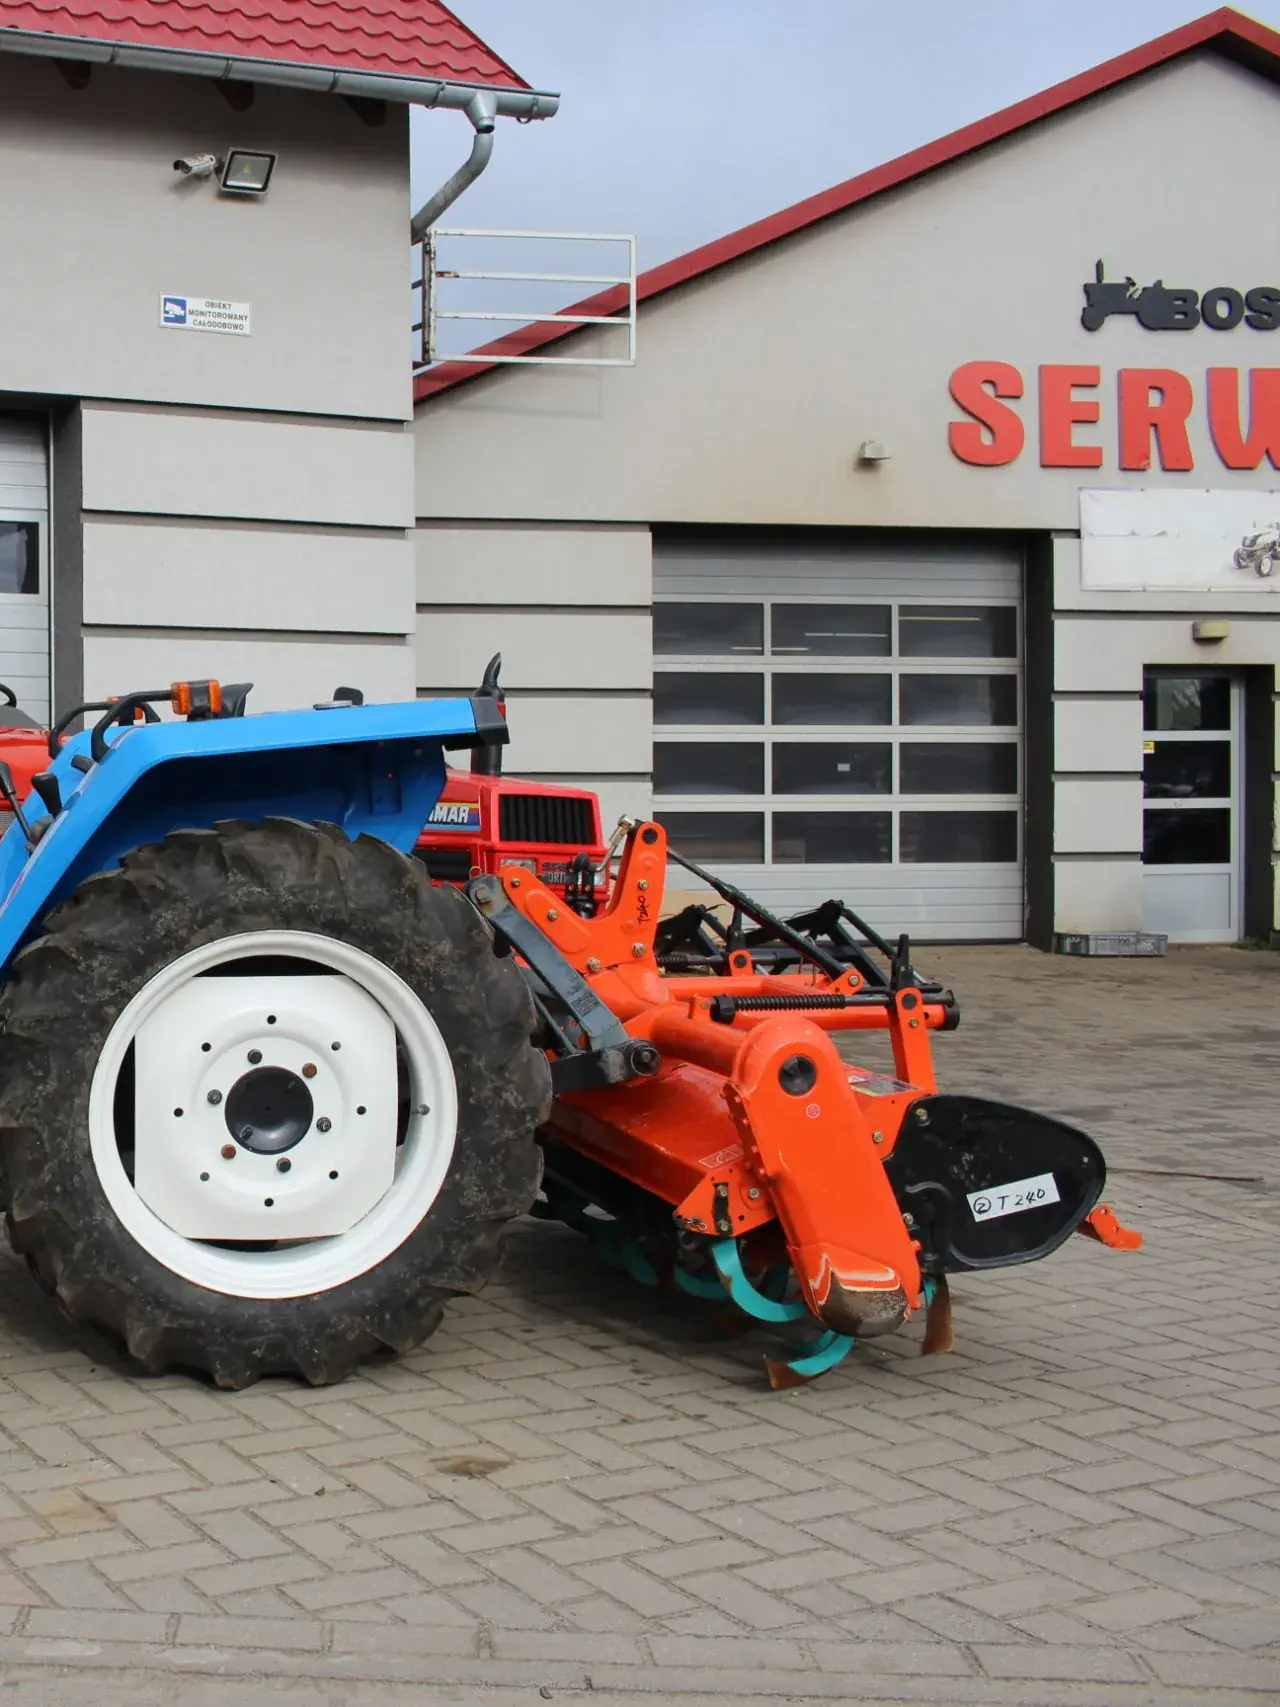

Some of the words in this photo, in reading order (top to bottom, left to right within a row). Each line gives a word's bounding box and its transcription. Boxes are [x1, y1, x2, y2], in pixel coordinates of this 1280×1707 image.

[205, 301, 232, 311] OBIEKT
[188, 309, 248, 321] MONITOROWANY
[428, 803, 470, 824] MAR
